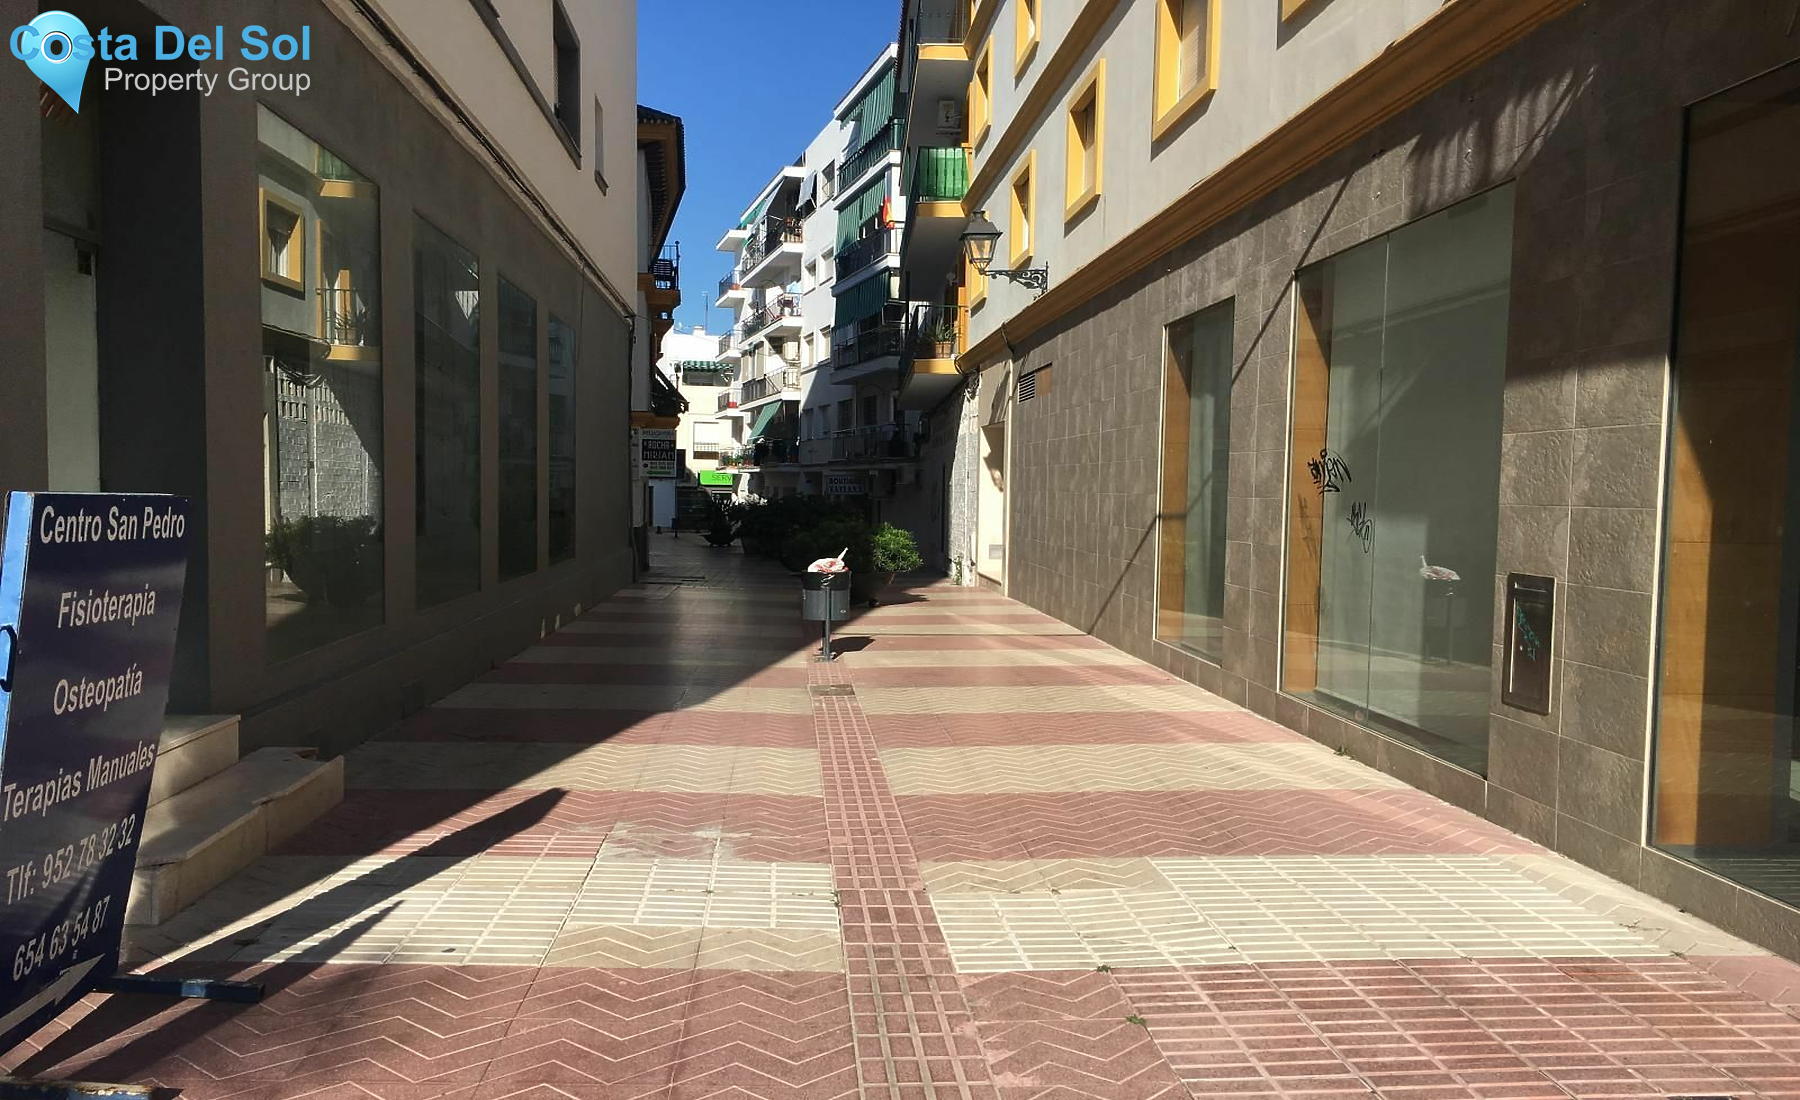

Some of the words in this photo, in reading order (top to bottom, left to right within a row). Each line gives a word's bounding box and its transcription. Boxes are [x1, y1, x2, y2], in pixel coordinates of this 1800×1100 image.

[40, 505, 102, 544] Centro
[107, 505, 138, 542] San
[142, 506, 185, 540] Pedro
[57, 583, 156, 629] Fisioterapia
[53, 663, 143, 716] Osteopatía
[3, 768, 82, 822] Terapias
[86, 740, 155, 792] Manuales
[7, 861, 37, 905] Tlf:
[41, 844, 74, 889] 952
[78, 833, 97, 872] 78
[98, 823, 117, 860] 32
[118, 813, 136, 850] 32
[13, 932, 46, 982] 654
[49, 920, 69, 960] 63
[71, 907, 91, 947] 54
[92, 894, 111, 934] 87
